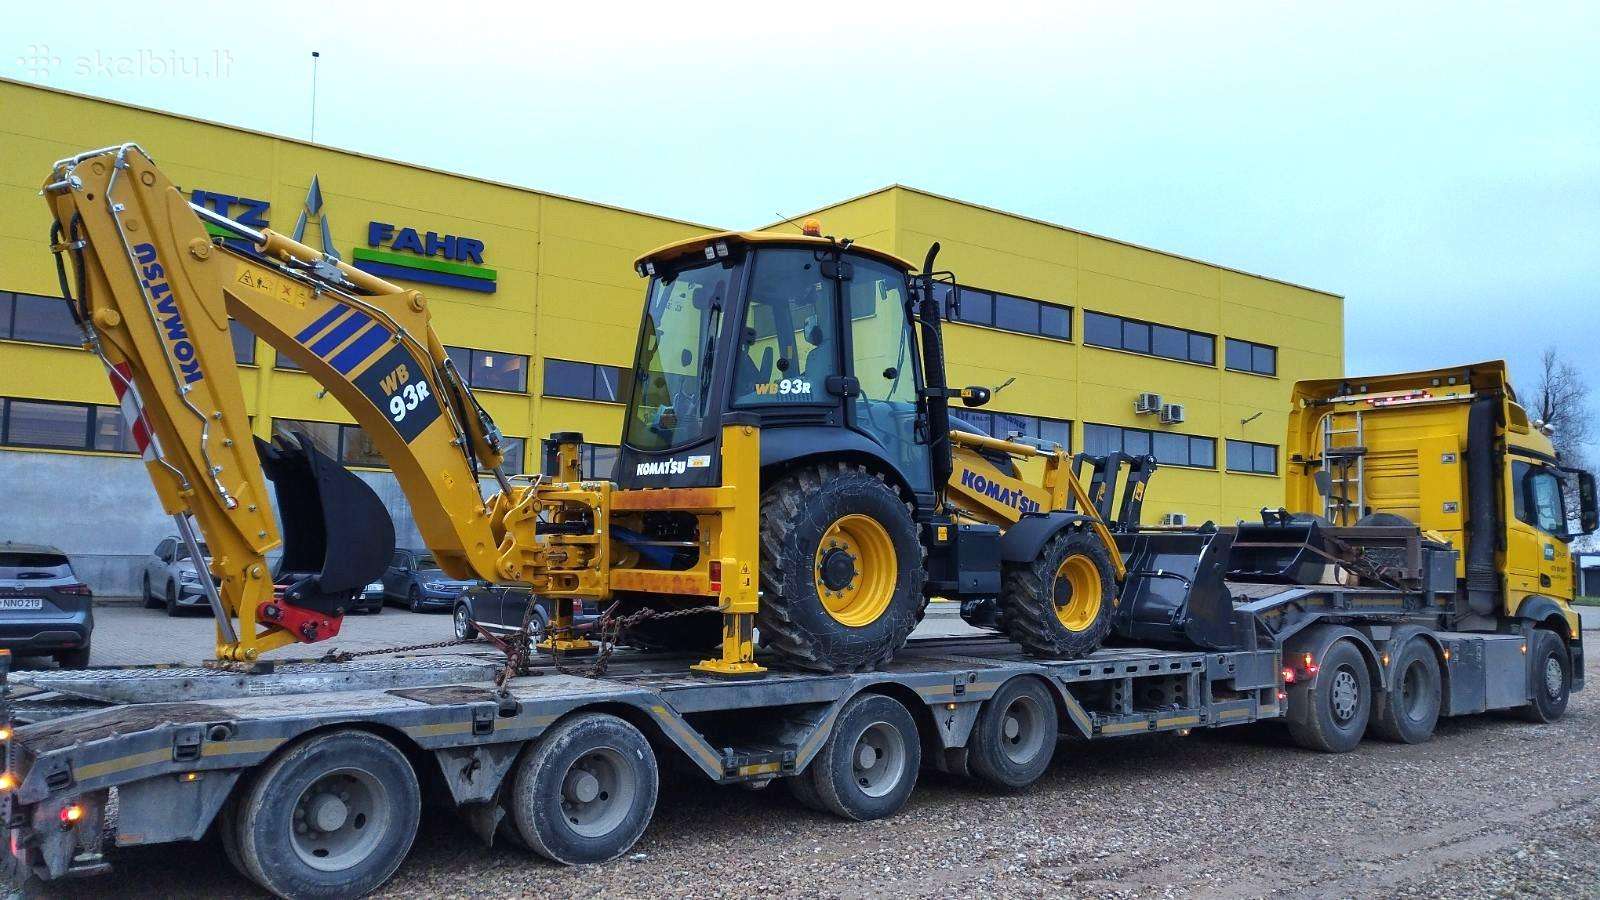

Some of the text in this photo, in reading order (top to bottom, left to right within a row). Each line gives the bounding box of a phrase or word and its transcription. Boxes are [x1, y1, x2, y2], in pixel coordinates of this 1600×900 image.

[368, 221, 485, 264] FAHR
[133, 242, 204, 384] KOMATSU
[379, 363, 410, 396] WB
[389, 380, 431, 422] 93R
[636, 458, 687, 476] KOMATSU
